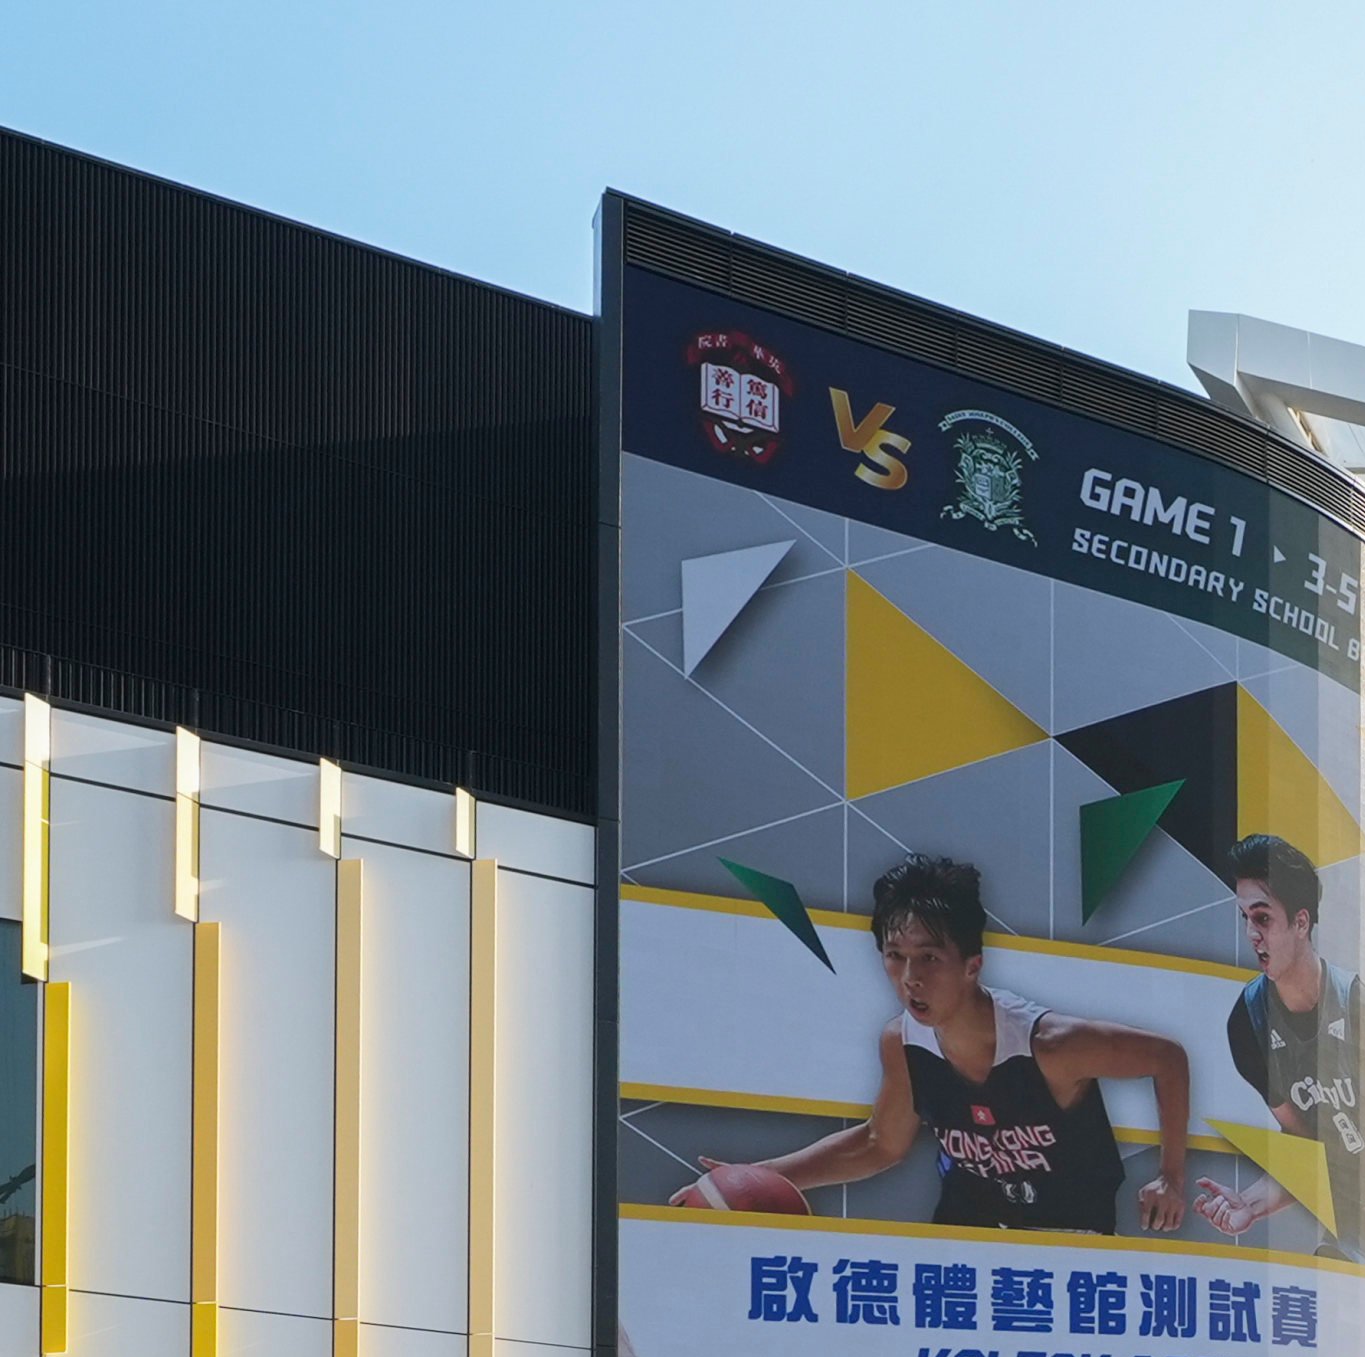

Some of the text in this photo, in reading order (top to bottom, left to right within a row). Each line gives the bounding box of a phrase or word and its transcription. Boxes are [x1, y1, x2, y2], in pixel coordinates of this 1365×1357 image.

[828, 386, 913, 490] VS
[1071, 527, 1245, 602] SECONDARY
[1252, 589, 1340, 650] SCHOOL
[1079, 468, 1216, 545] GAME
[1229, 515, 1247, 557] 1
[1303, 552, 1359, 616] 3-5
[1332, 1111, 1365, 1154] 8
[747, 1255, 1318, 1348] 啟德體藝館測試賽
